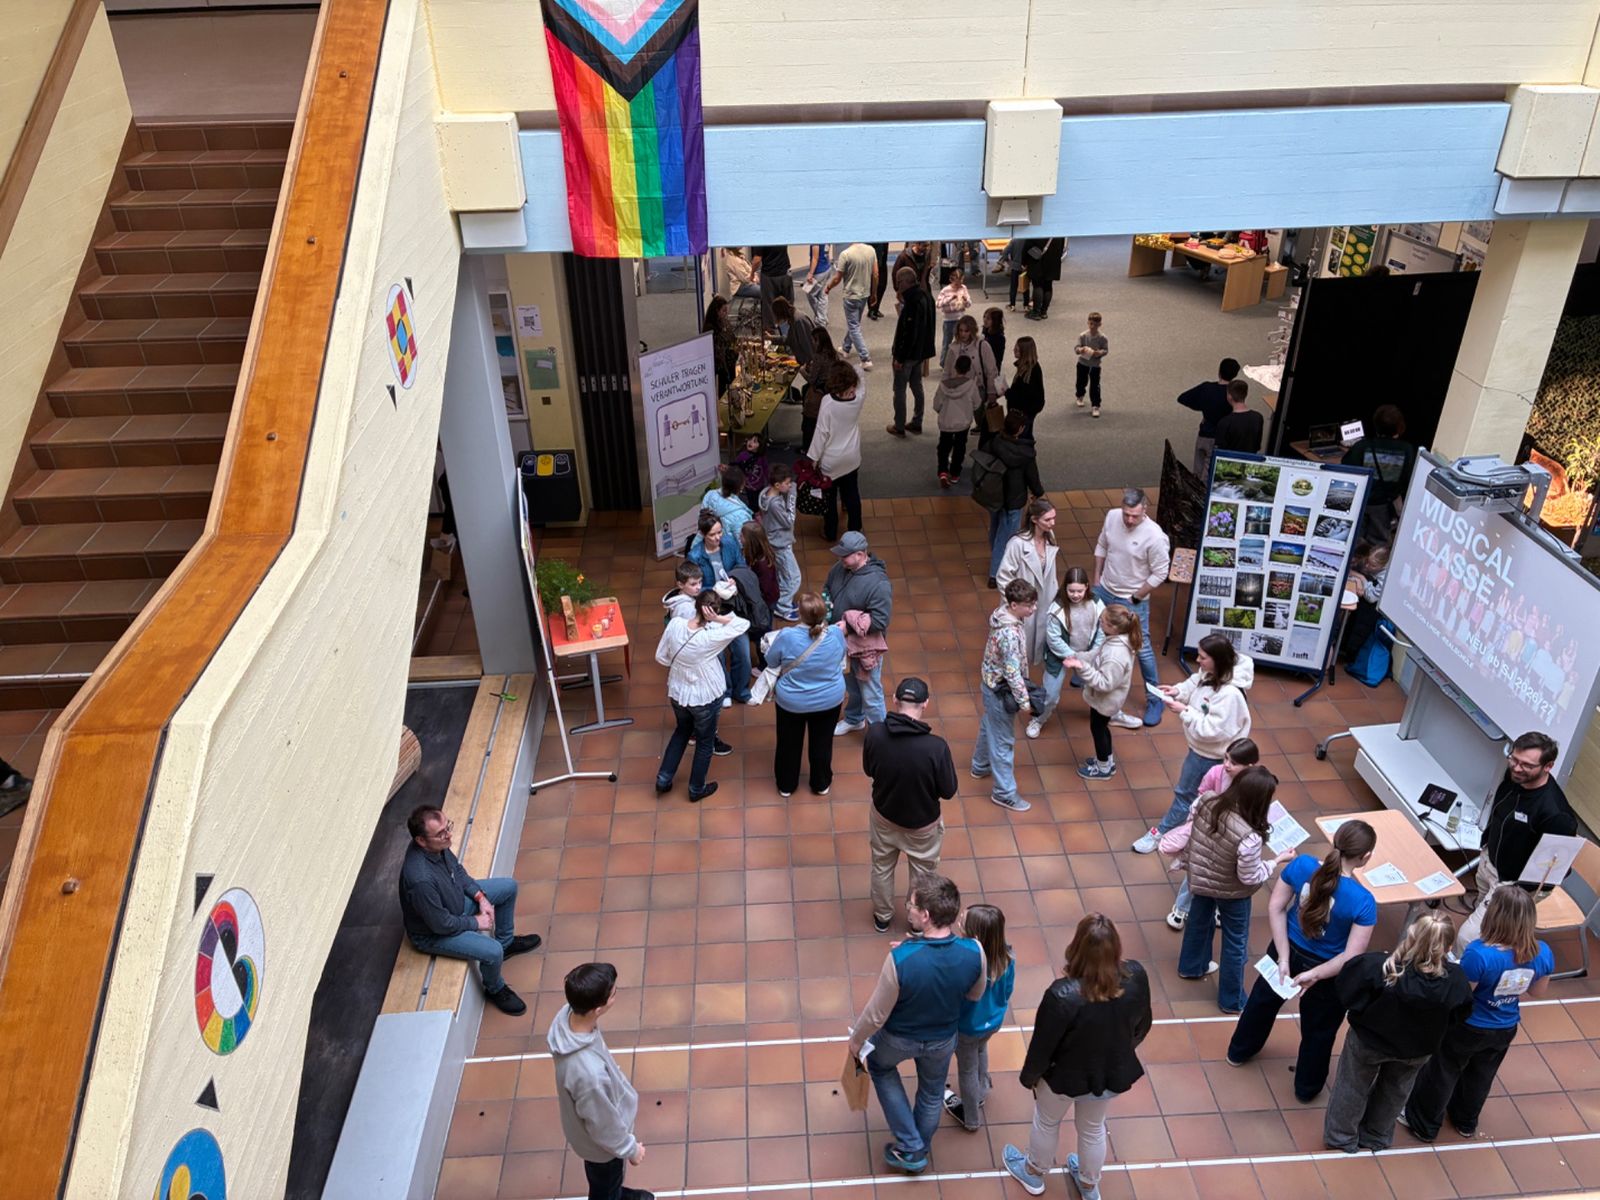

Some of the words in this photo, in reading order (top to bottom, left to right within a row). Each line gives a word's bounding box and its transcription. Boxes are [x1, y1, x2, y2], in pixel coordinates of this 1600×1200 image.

[651, 375, 709, 402] VERANTWORTUNG
[681, 363, 706, 379] TRAGEN
[1412, 519, 1495, 605] KLASSE
[1421, 490, 1515, 588] MUSICAL
[1466, 633, 1487, 655] NEU
[1488, 655, 1500, 668] ab
[1515, 677, 1554, 716] 2026/27
